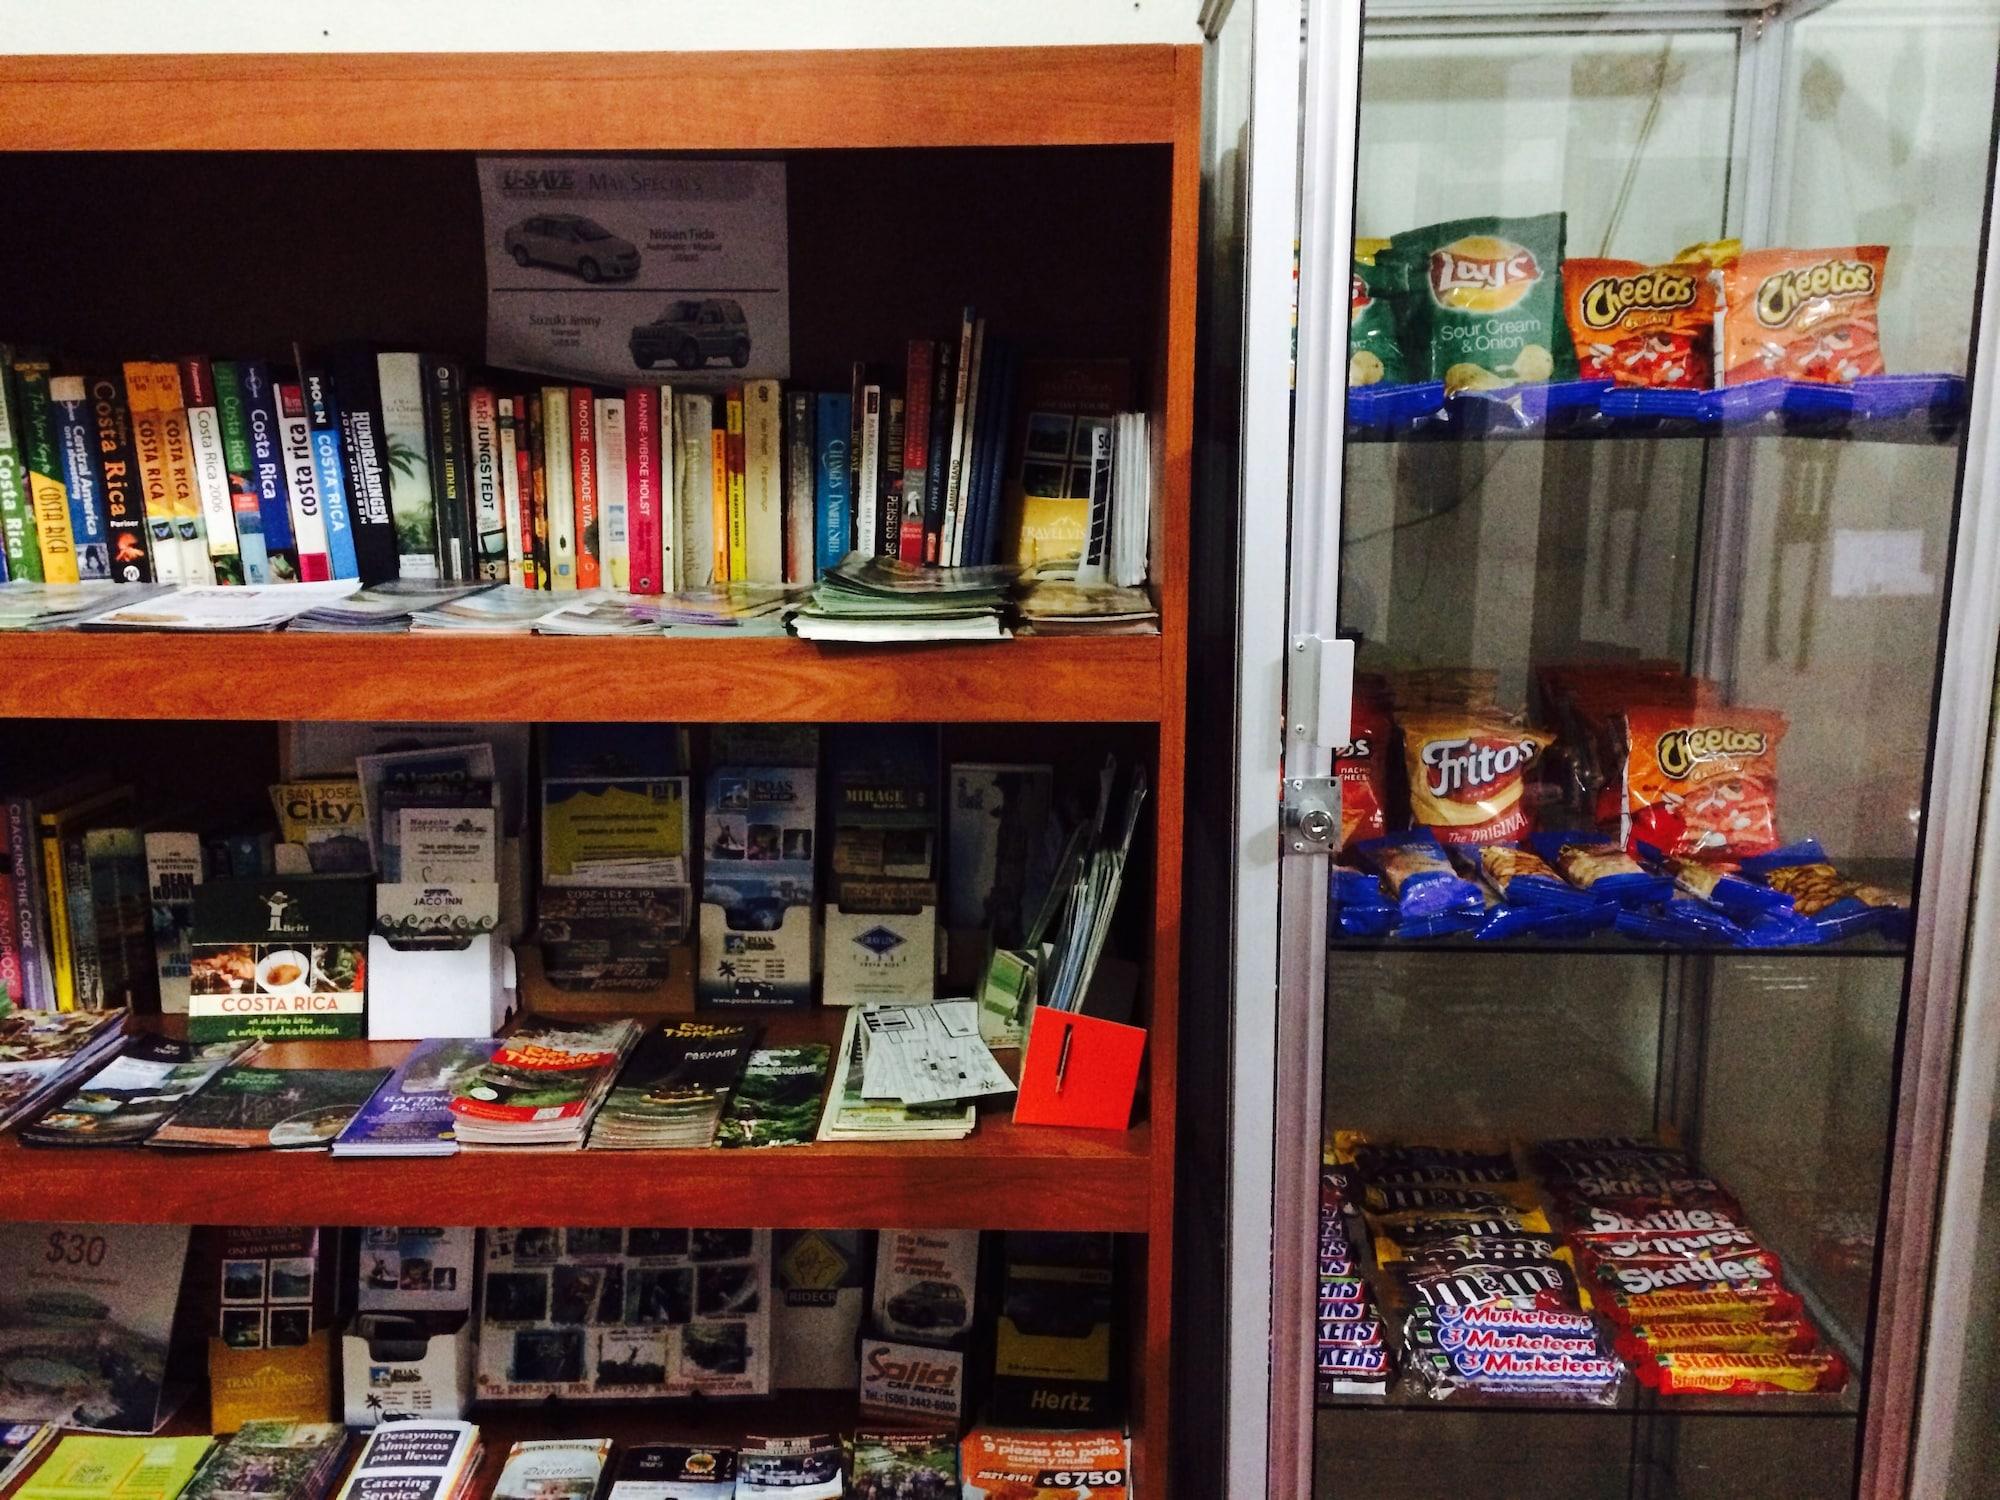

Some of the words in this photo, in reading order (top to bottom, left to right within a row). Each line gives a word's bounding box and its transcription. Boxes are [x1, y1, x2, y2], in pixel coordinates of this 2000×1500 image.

[503, 169, 574, 189] U-SAVE
[1584, 272, 1695, 328] Cheetos
[1759, 261, 1873, 328] Cheetos
[1441, 324, 1480, 340] Sour
[1486, 318, 1541, 333] Cream
[1462, 340, 1471, 353] &
[1475, 335, 1524, 350] Onion
[94, 381, 117, 453] Costa
[197, 410, 212, 448] Costa
[224, 397, 240, 435] Costa
[251, 408, 271, 459] Costa
[578, 399, 590, 443] MOORE
[73, 425, 88, 475] Central
[138, 420, 159, 463] COSTA
[165, 419, 184, 462] COSTA
[287, 423, 307, 460] rica
[637, 393, 650, 477] HANNE-VIBEKE
[867, 418, 875, 456] PATRICIA
[205, 452, 219, 481] Rica
[231, 440, 246, 470] Rica
[341, 411, 354, 453] JONAS
[350, 457, 367, 525] JONASSON
[478, 425, 495, 511] JUNGSTEDT
[822, 439, 845, 489] CHANGES
[1, 454, 16, 510] Costa
[104, 460, 127, 516] Rica
[146, 468, 164, 501] RICA
[174, 468, 189, 501] RICA
[259, 462, 278, 500] Rica
[295, 466, 318, 517] costa
[319, 434, 339, 491] COSTA
[329, 494, 344, 532] RICA
[580, 448, 592, 503] KORKADE
[865, 457, 874, 503] CORNWELL
[948, 459, 959, 513] SAMMELBAND
[39, 486, 64, 521] COSTA
[80, 476, 98, 536] America
[209, 480, 222, 513] 2006
[639, 479, 650, 516] HOLST
[6, 517, 23, 559] Rica
[45, 526, 69, 554] RICA
[1422, 738, 1536, 798] Fritos
[1657, 727, 1766, 779] Cheetos
[286, 800, 357, 823] City
[845, 789, 903, 803] MIRAGE
[9, 803, 25, 877] CRACKING
[17, 879, 28, 906] THE
[21, 908, 33, 947] CODE
[221, 997, 288, 1012] COSTA
[294, 996, 339, 1011] RICA
[277, 1025, 339, 1037] destination
[46, 1232, 106, 1267] $30
[1617, 1258, 1773, 1293] Skittles
[1633, 1290, 1743, 1308] Starburst
[1464, 1308, 1592, 1328] Musketeers
[1653, 1321, 1760, 1340] Starburst
[1467, 1330, 1596, 1353] Musketeers
[865, 1347, 958, 1385] Solid
[1464, 1354, 1478, 1368] 3
[1484, 1356, 1616, 1375] Musketeers
[1674, 1353, 1788, 1369] Starburst
[888, 1381, 911, 1390] CAR
[913, 1384, 956, 1397] RENTAL
[1673, 1374, 1737, 1387] Starburst
[1030, 1389, 1092, 1411] Hertz
[375, 1441, 449, 1451] Almuerzos
[380, 1432, 454, 1442] Desayunos
[862, 1433, 880, 1441] The
[983, 1442, 995, 1454] 9
[998, 1445, 1051, 1459] piezas
[1055, 1445, 1076, 1456] de
[1078, 1445, 1121, 1459] pollo
[370, 1452, 402, 1464] para
[404, 1450, 445, 1461] llevar
[360, 1490, 421, 1500] Service
[361, 1477, 433, 1491] Catering
[1054, 1470, 1122, 1486] 6750
